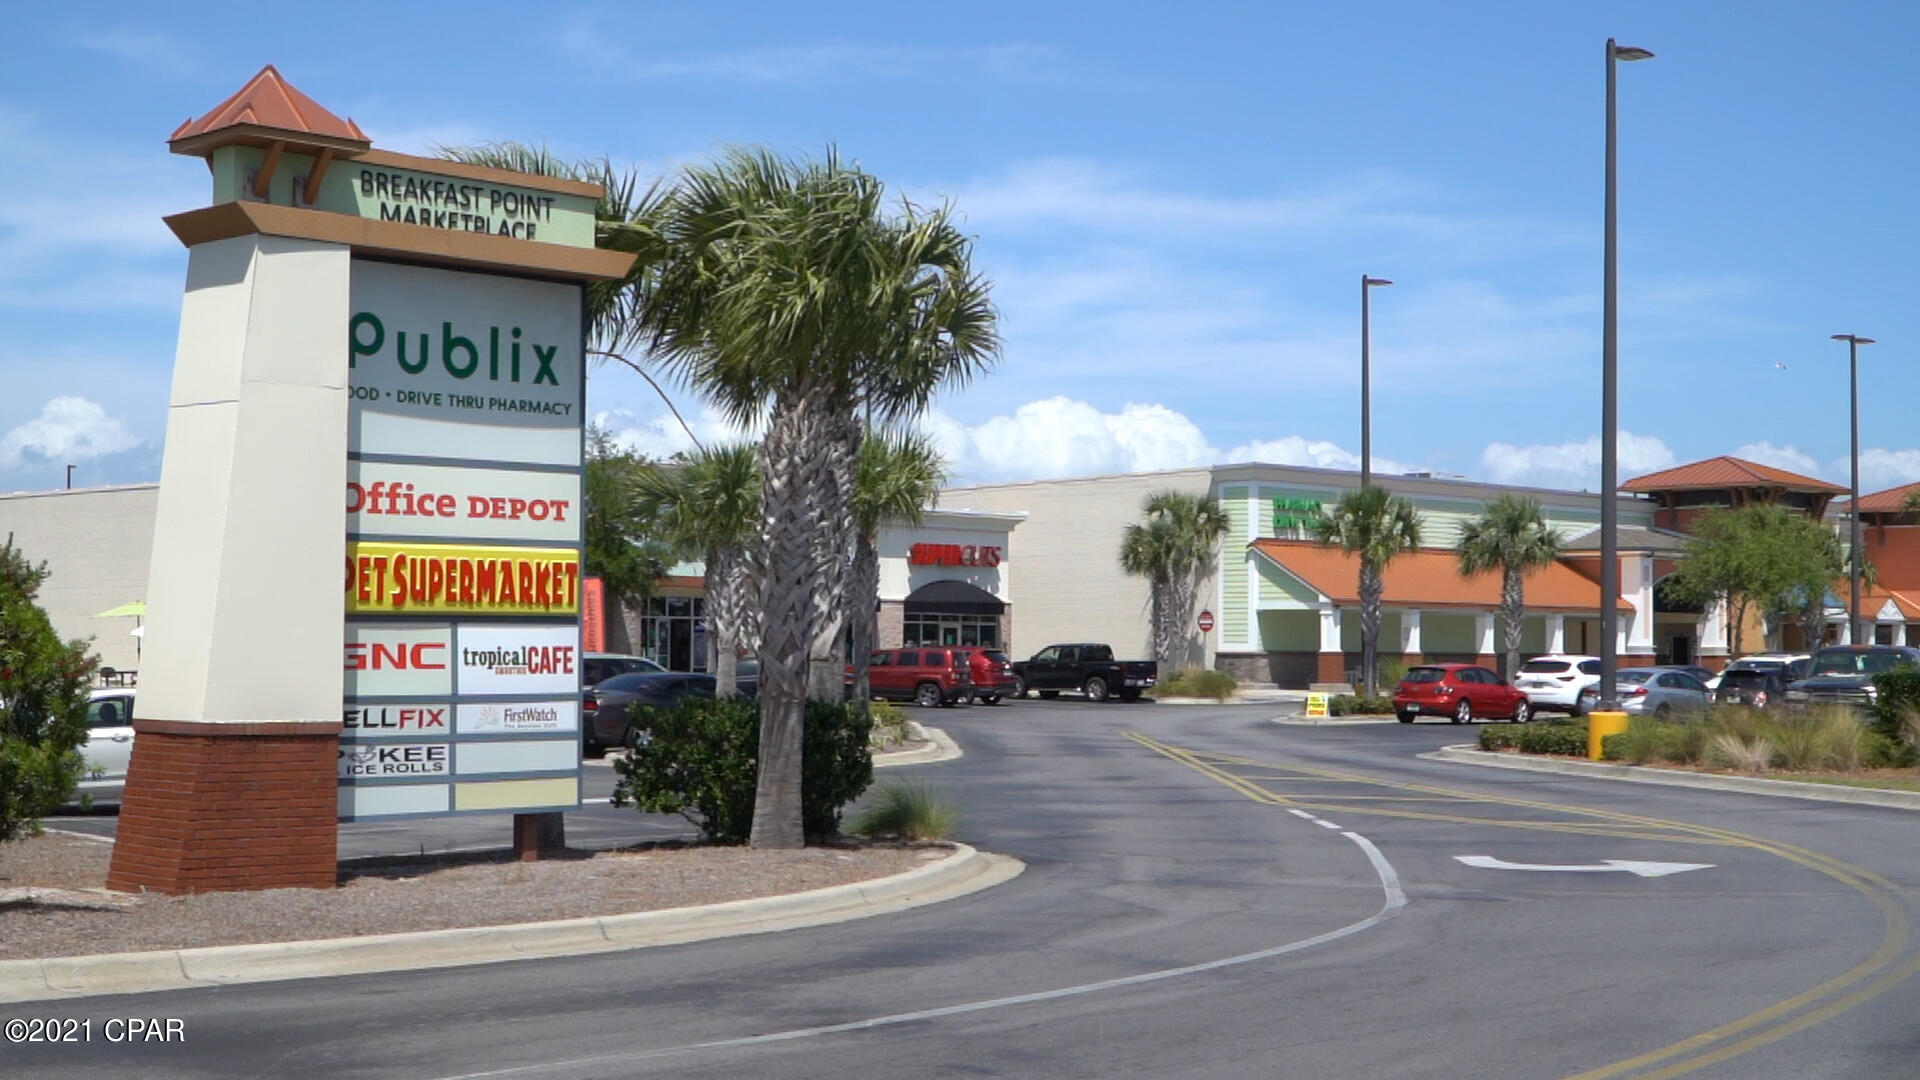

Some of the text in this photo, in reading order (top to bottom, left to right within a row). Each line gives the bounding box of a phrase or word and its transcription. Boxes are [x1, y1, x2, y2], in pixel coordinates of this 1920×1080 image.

[360, 170, 555, 223] BREAKFAST POINT
[380, 202, 536, 240] MARKETPLACE
[349, 311, 559, 386] Publix
[348, 385, 572, 416] OOD DRIVE THRU PHARMACY
[346, 481, 569, 522] Office DEPOT
[391, 552, 579, 609] SUPERMARKET
[344, 643, 446, 670] GNC
[463, 646, 575, 675] tropical CAFE
[344, 708, 445, 730] ELLFIX
[346, 762, 444, 775] ICE ROLLS
